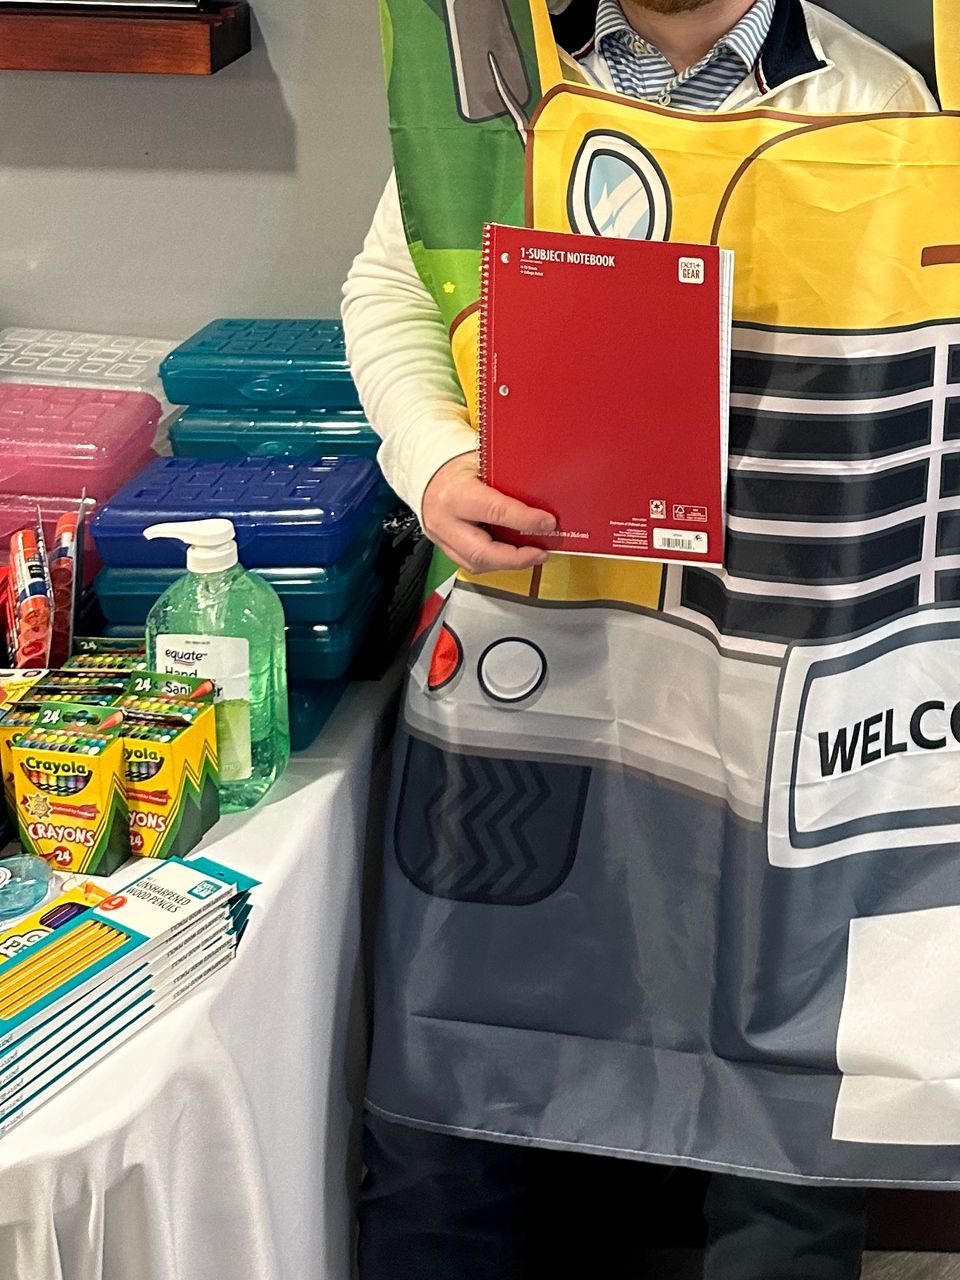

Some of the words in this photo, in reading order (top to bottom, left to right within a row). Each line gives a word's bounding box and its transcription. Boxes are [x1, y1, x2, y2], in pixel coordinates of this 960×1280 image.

[520, 247, 565, 262] 1-SUBJECT
[567, 252, 615, 267] NOTEBOOK
[683, 269, 700, 279] GEAR
[81, 641, 97, 651] 24
[165, 648, 203, 662] equate
[165, 665, 198, 678] Hand
[135, 678, 152, 692] 24
[43, 709, 60, 724] 24
[124, 747, 159, 761] yola
[26, 756, 87, 775] Crayola
[129, 811, 166, 832] YONS
[28, 823, 95, 847] CRAYONS
[55, 849, 71, 862] 24
[126, 887, 153, 901] WOOD
[149, 895, 182, 914] PENCILS
[136, 880, 191, 907] UNSHARPENED
